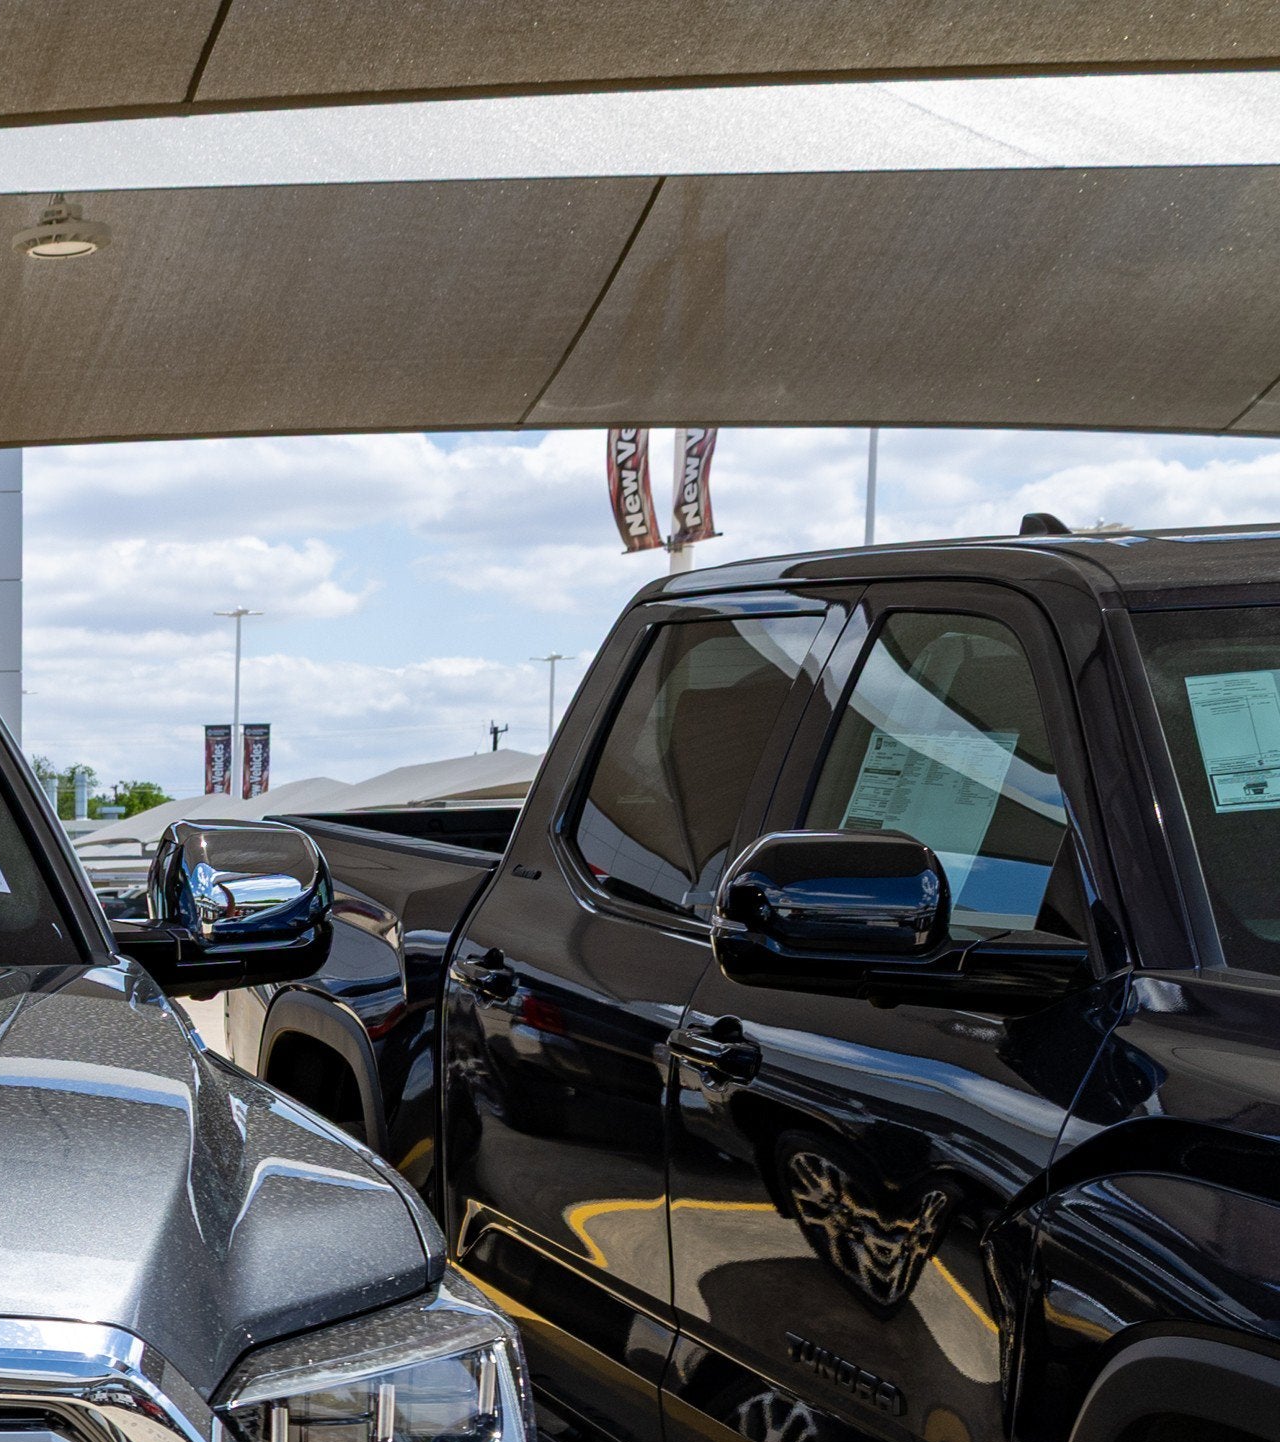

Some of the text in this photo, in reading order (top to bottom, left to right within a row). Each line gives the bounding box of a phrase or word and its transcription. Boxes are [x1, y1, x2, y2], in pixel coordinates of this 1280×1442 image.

[621, 469, 648, 537] New
[681, 456, 702, 527] New
[212, 743, 224, 783] Vehicles
[249, 743, 262, 783] Vehicles
[785, 1330, 908, 1417] TUNDRA
